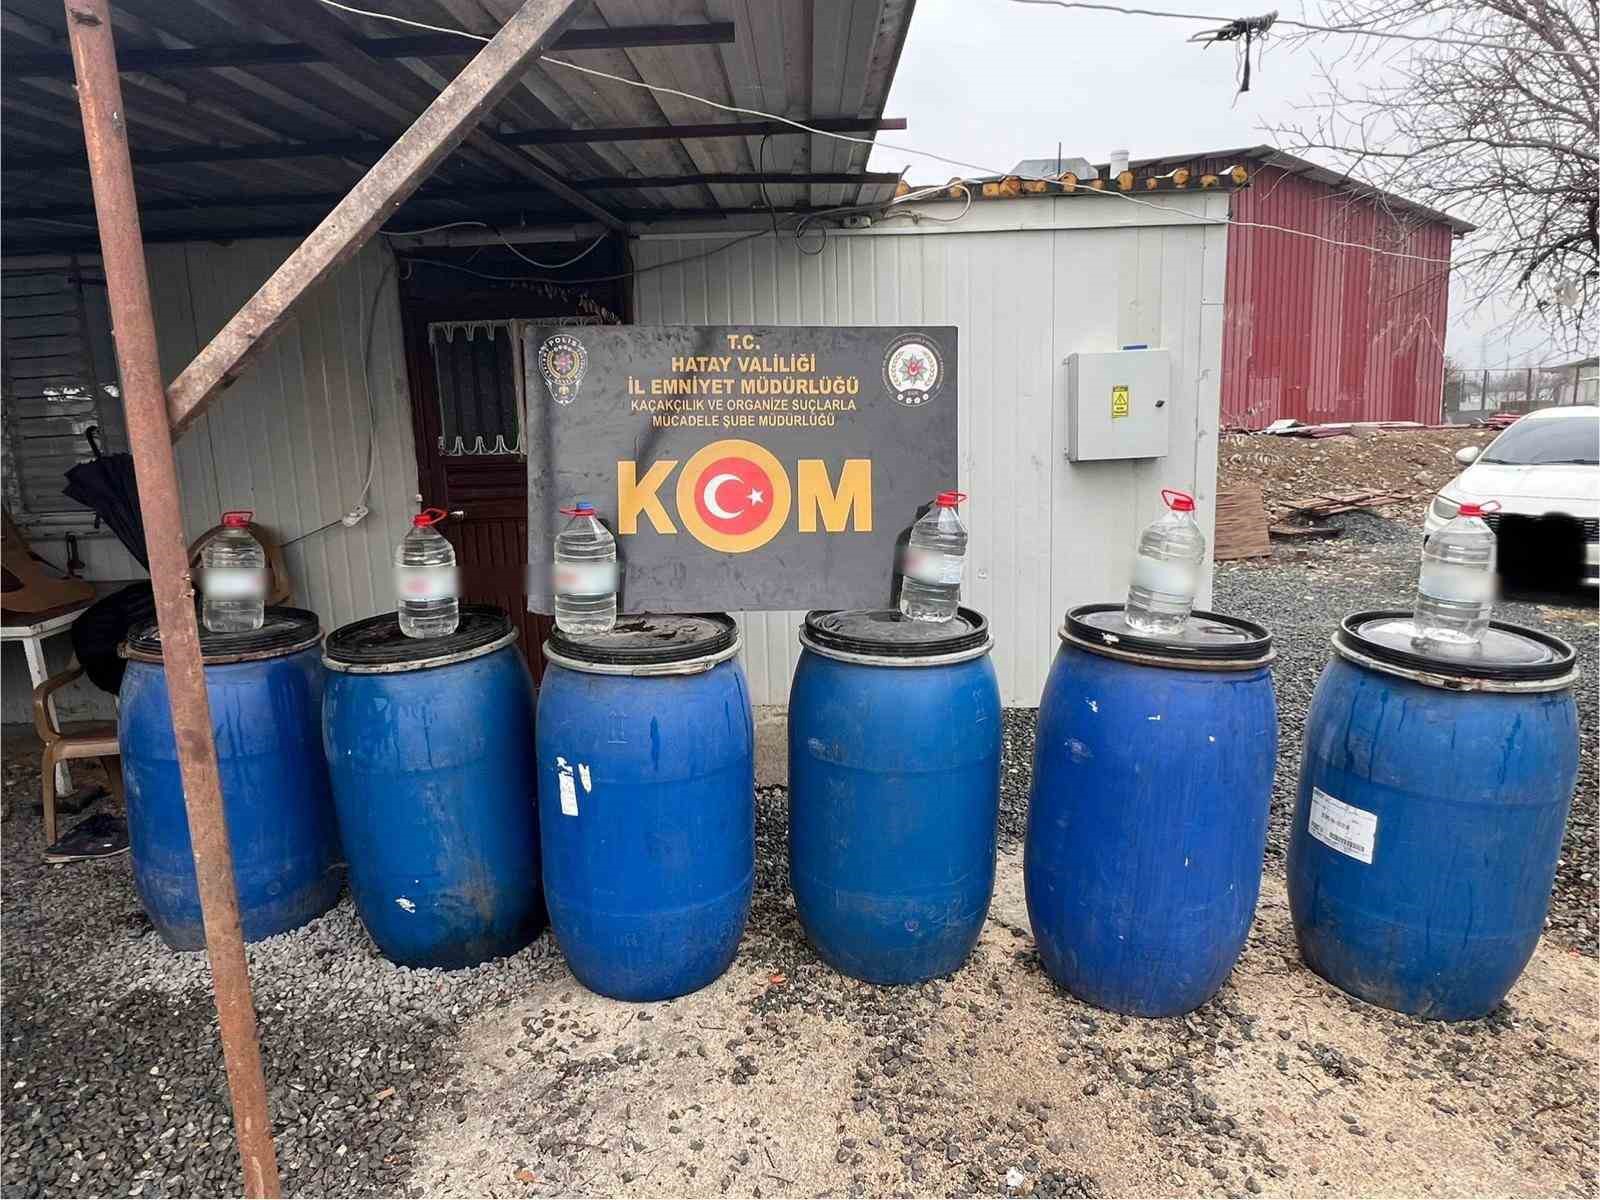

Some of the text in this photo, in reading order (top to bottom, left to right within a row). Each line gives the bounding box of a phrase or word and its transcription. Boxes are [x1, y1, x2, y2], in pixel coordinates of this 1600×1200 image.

[727, 334, 760, 350] T.C.
[671, 353, 816, 372] HATAY VALİLİĞİ
[628, 376, 859, 395] İL EMNİYET MÜDÜRLÜĞÜ
[631, 397, 857, 413] KAÇAKÇILIK VE ORGANİZE SUÇLARLA
[723, 415, 755, 428] ŞUBE
[758, 412, 835, 427] MÜDÜRLÜĞÜ
[617, 439, 872, 554] KOM
